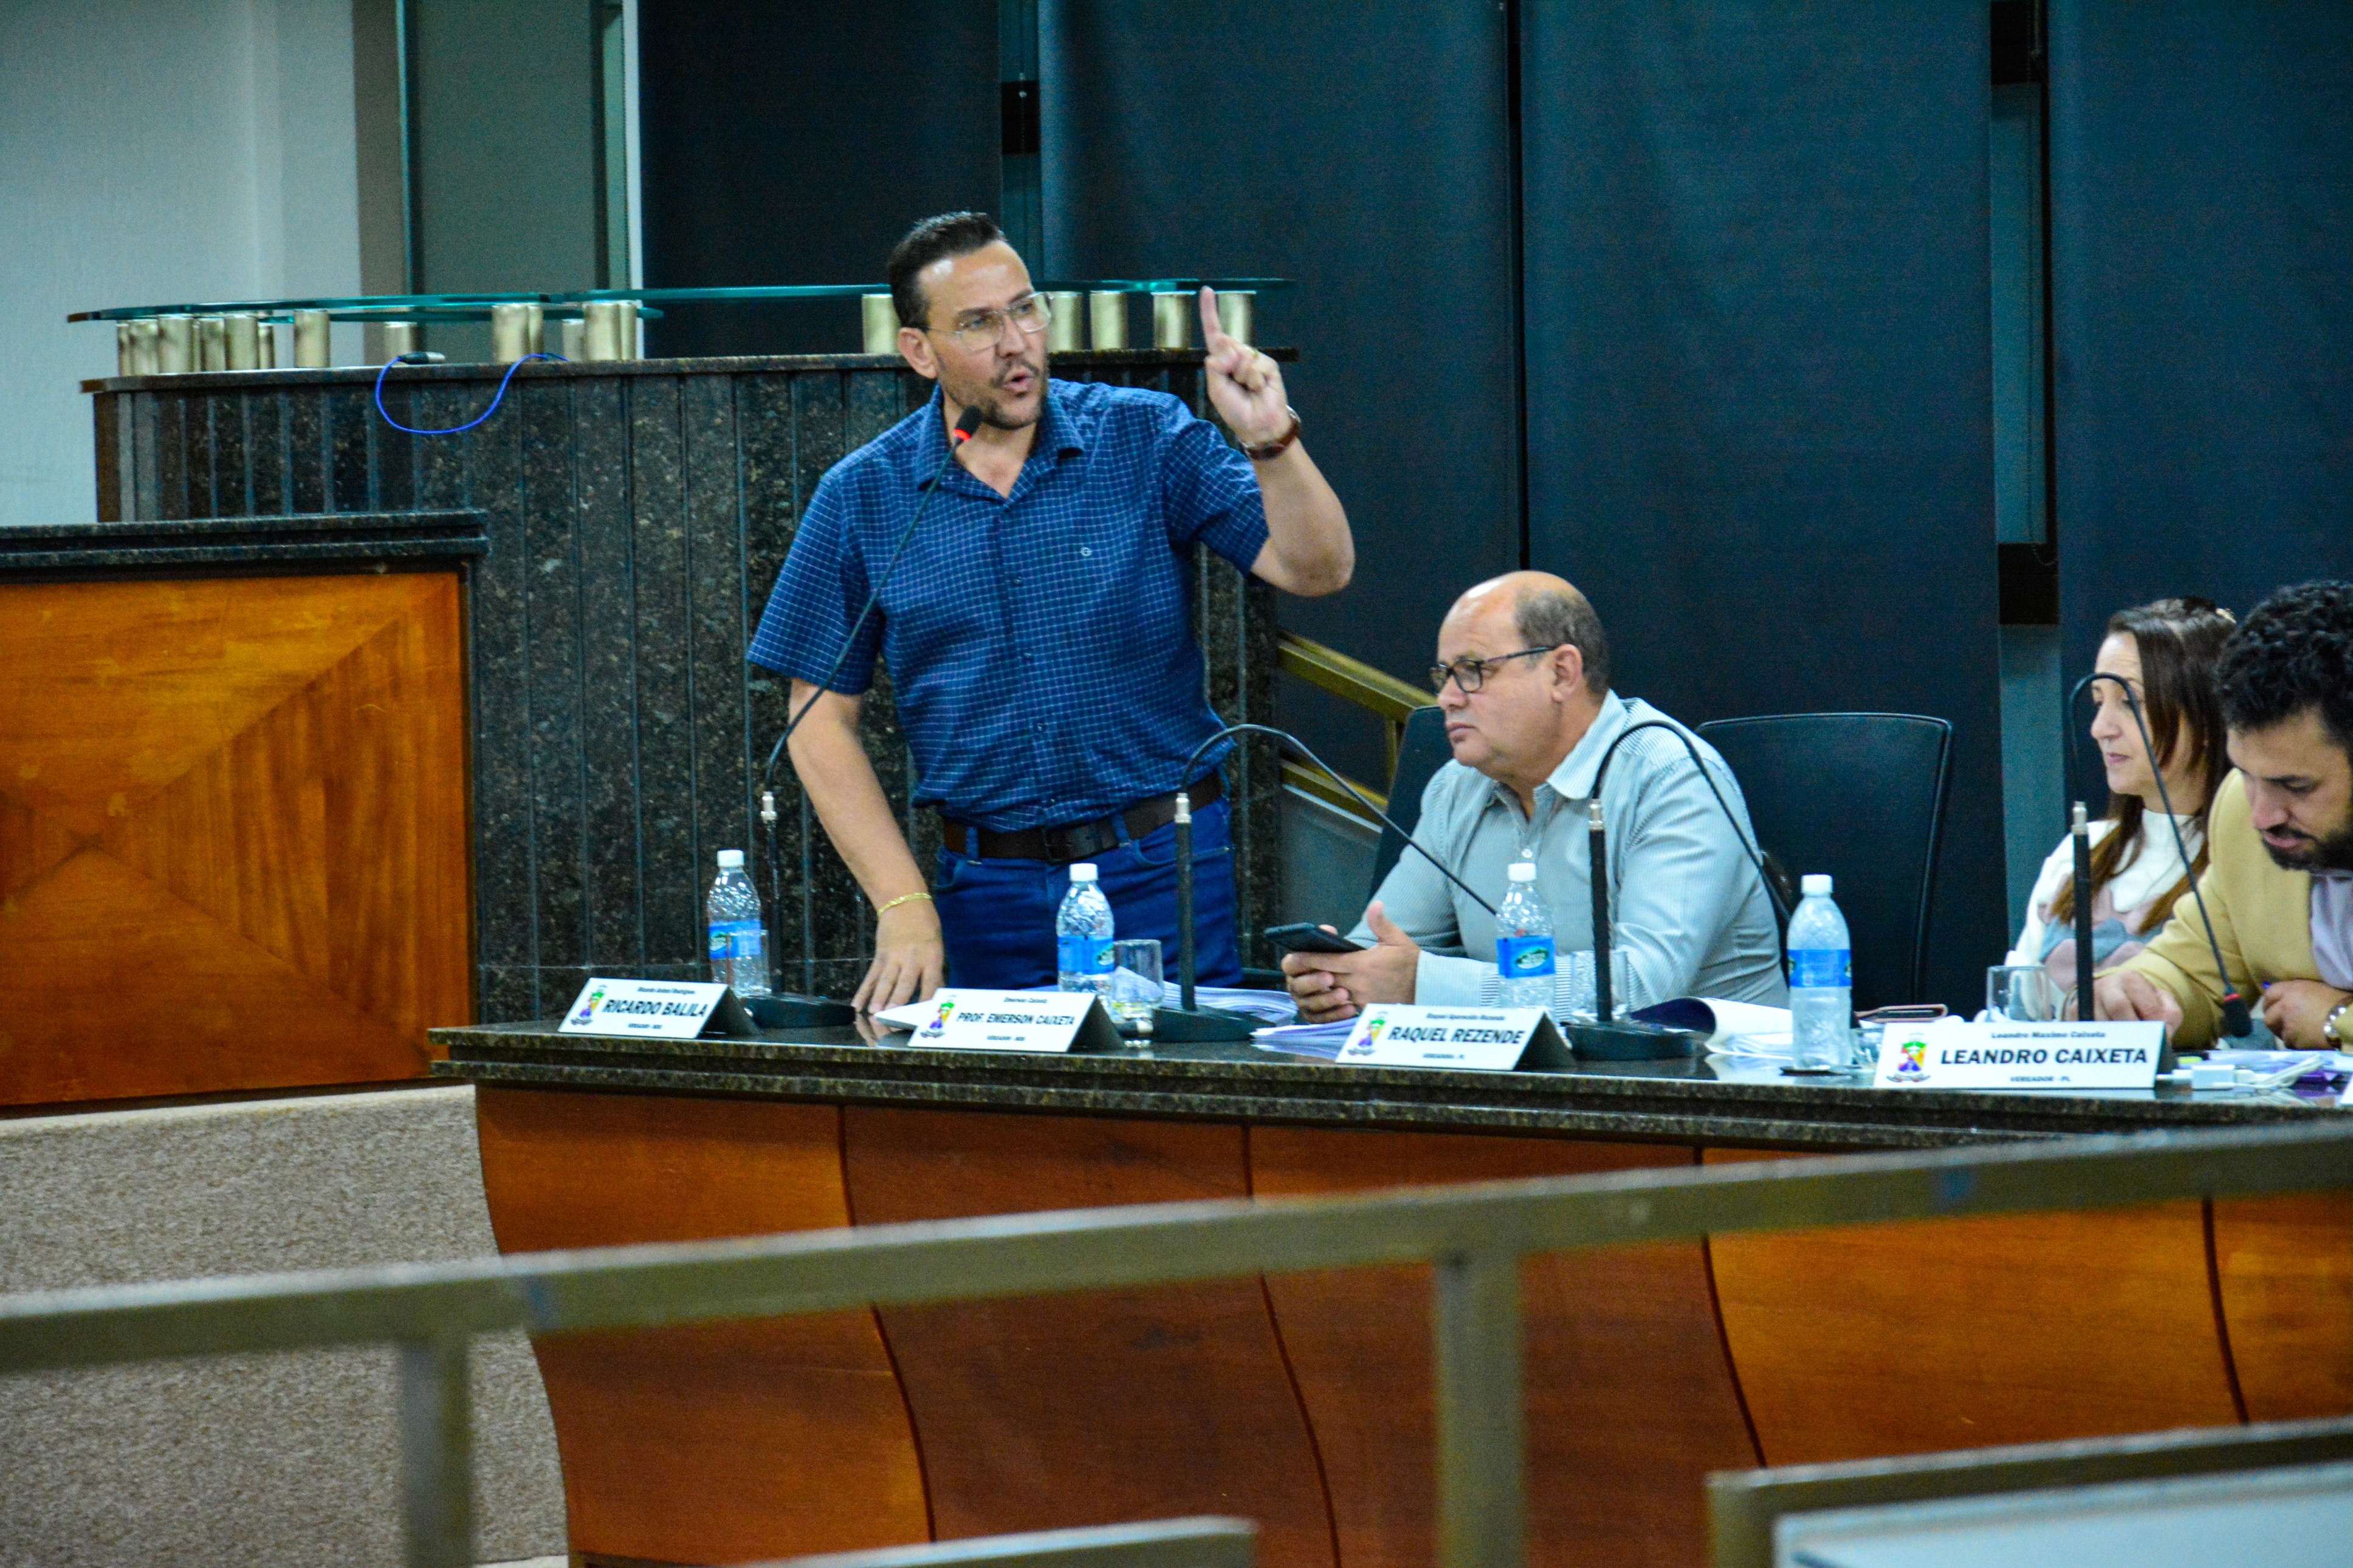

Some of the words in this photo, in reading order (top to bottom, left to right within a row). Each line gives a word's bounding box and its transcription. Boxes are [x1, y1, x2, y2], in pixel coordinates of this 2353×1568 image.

[602, 999, 662, 1015] RICARDO
[986, 1013, 1034, 1024] EMERSON
[1036, 1015, 1075, 1025] CAIXETA
[1387, 1026, 1448, 1042] RAQUEL
[1451, 1028, 1525, 1044] REZENDE
[1941, 1049, 2048, 1064] LEANDRO
[2055, 1048, 2148, 1063] CAIXETA
